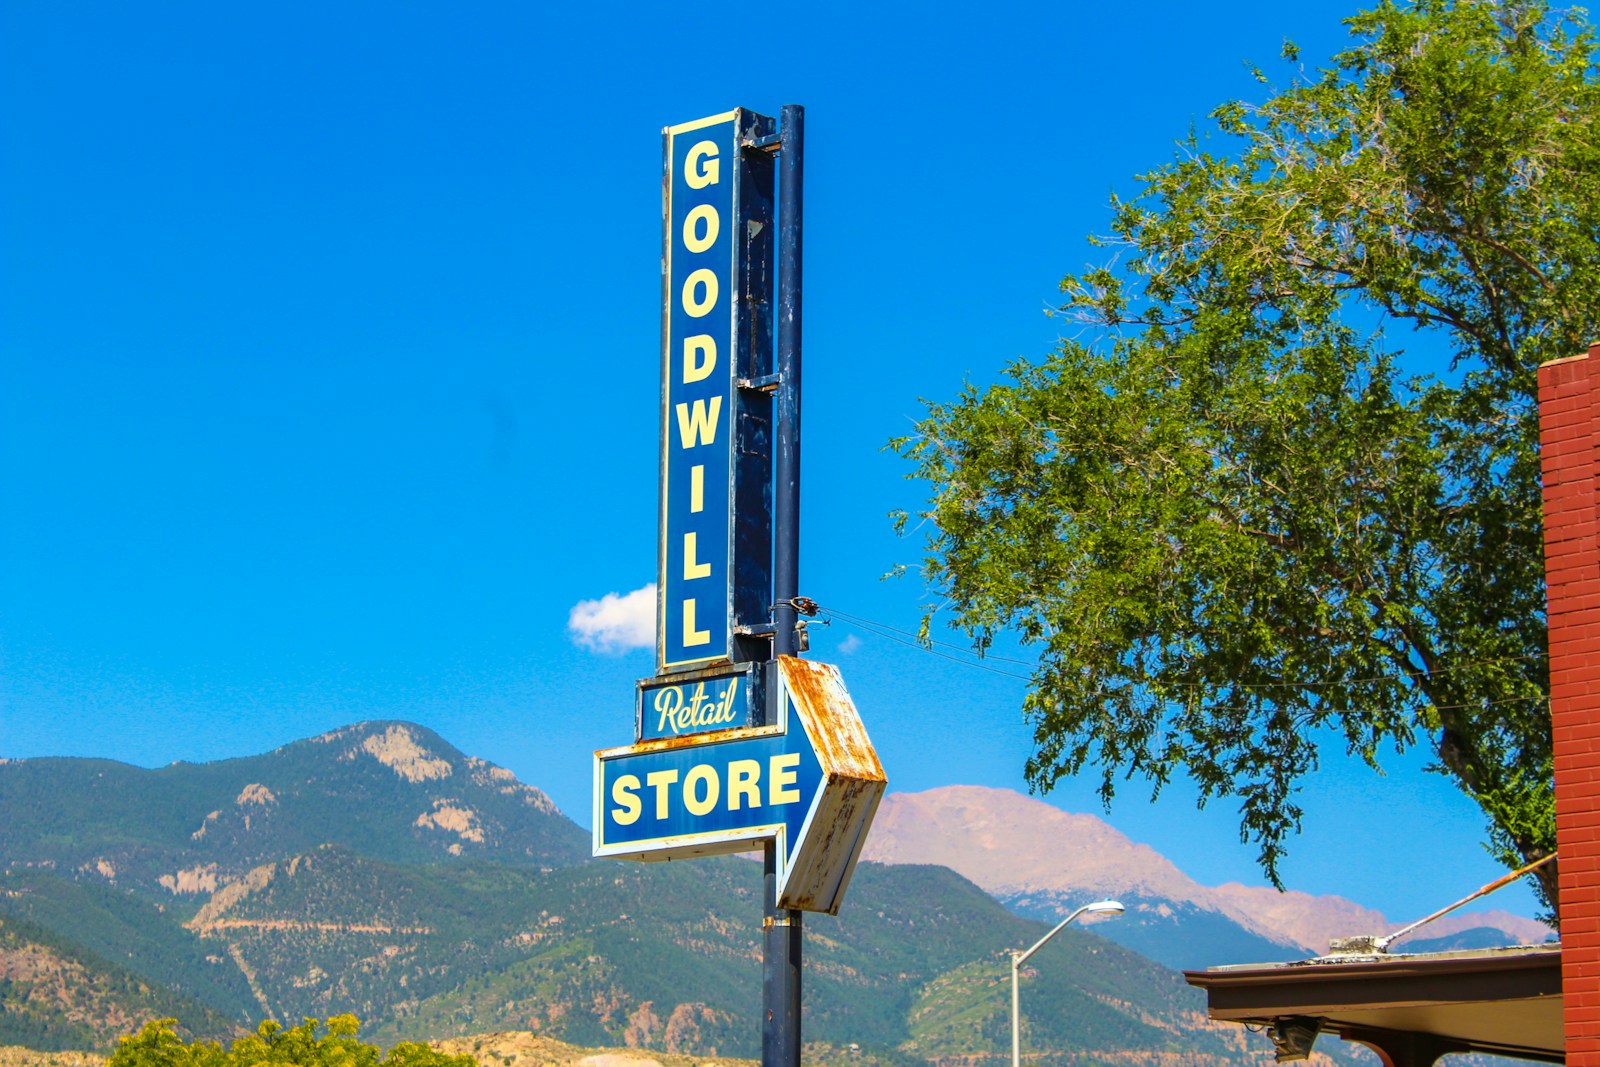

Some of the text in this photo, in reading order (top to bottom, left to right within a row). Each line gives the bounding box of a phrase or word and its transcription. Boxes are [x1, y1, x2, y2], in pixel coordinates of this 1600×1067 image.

[676, 140, 723, 648] GOODWILL
[654, 676, 738, 734] Retail
[611, 752, 800, 826] STORE
